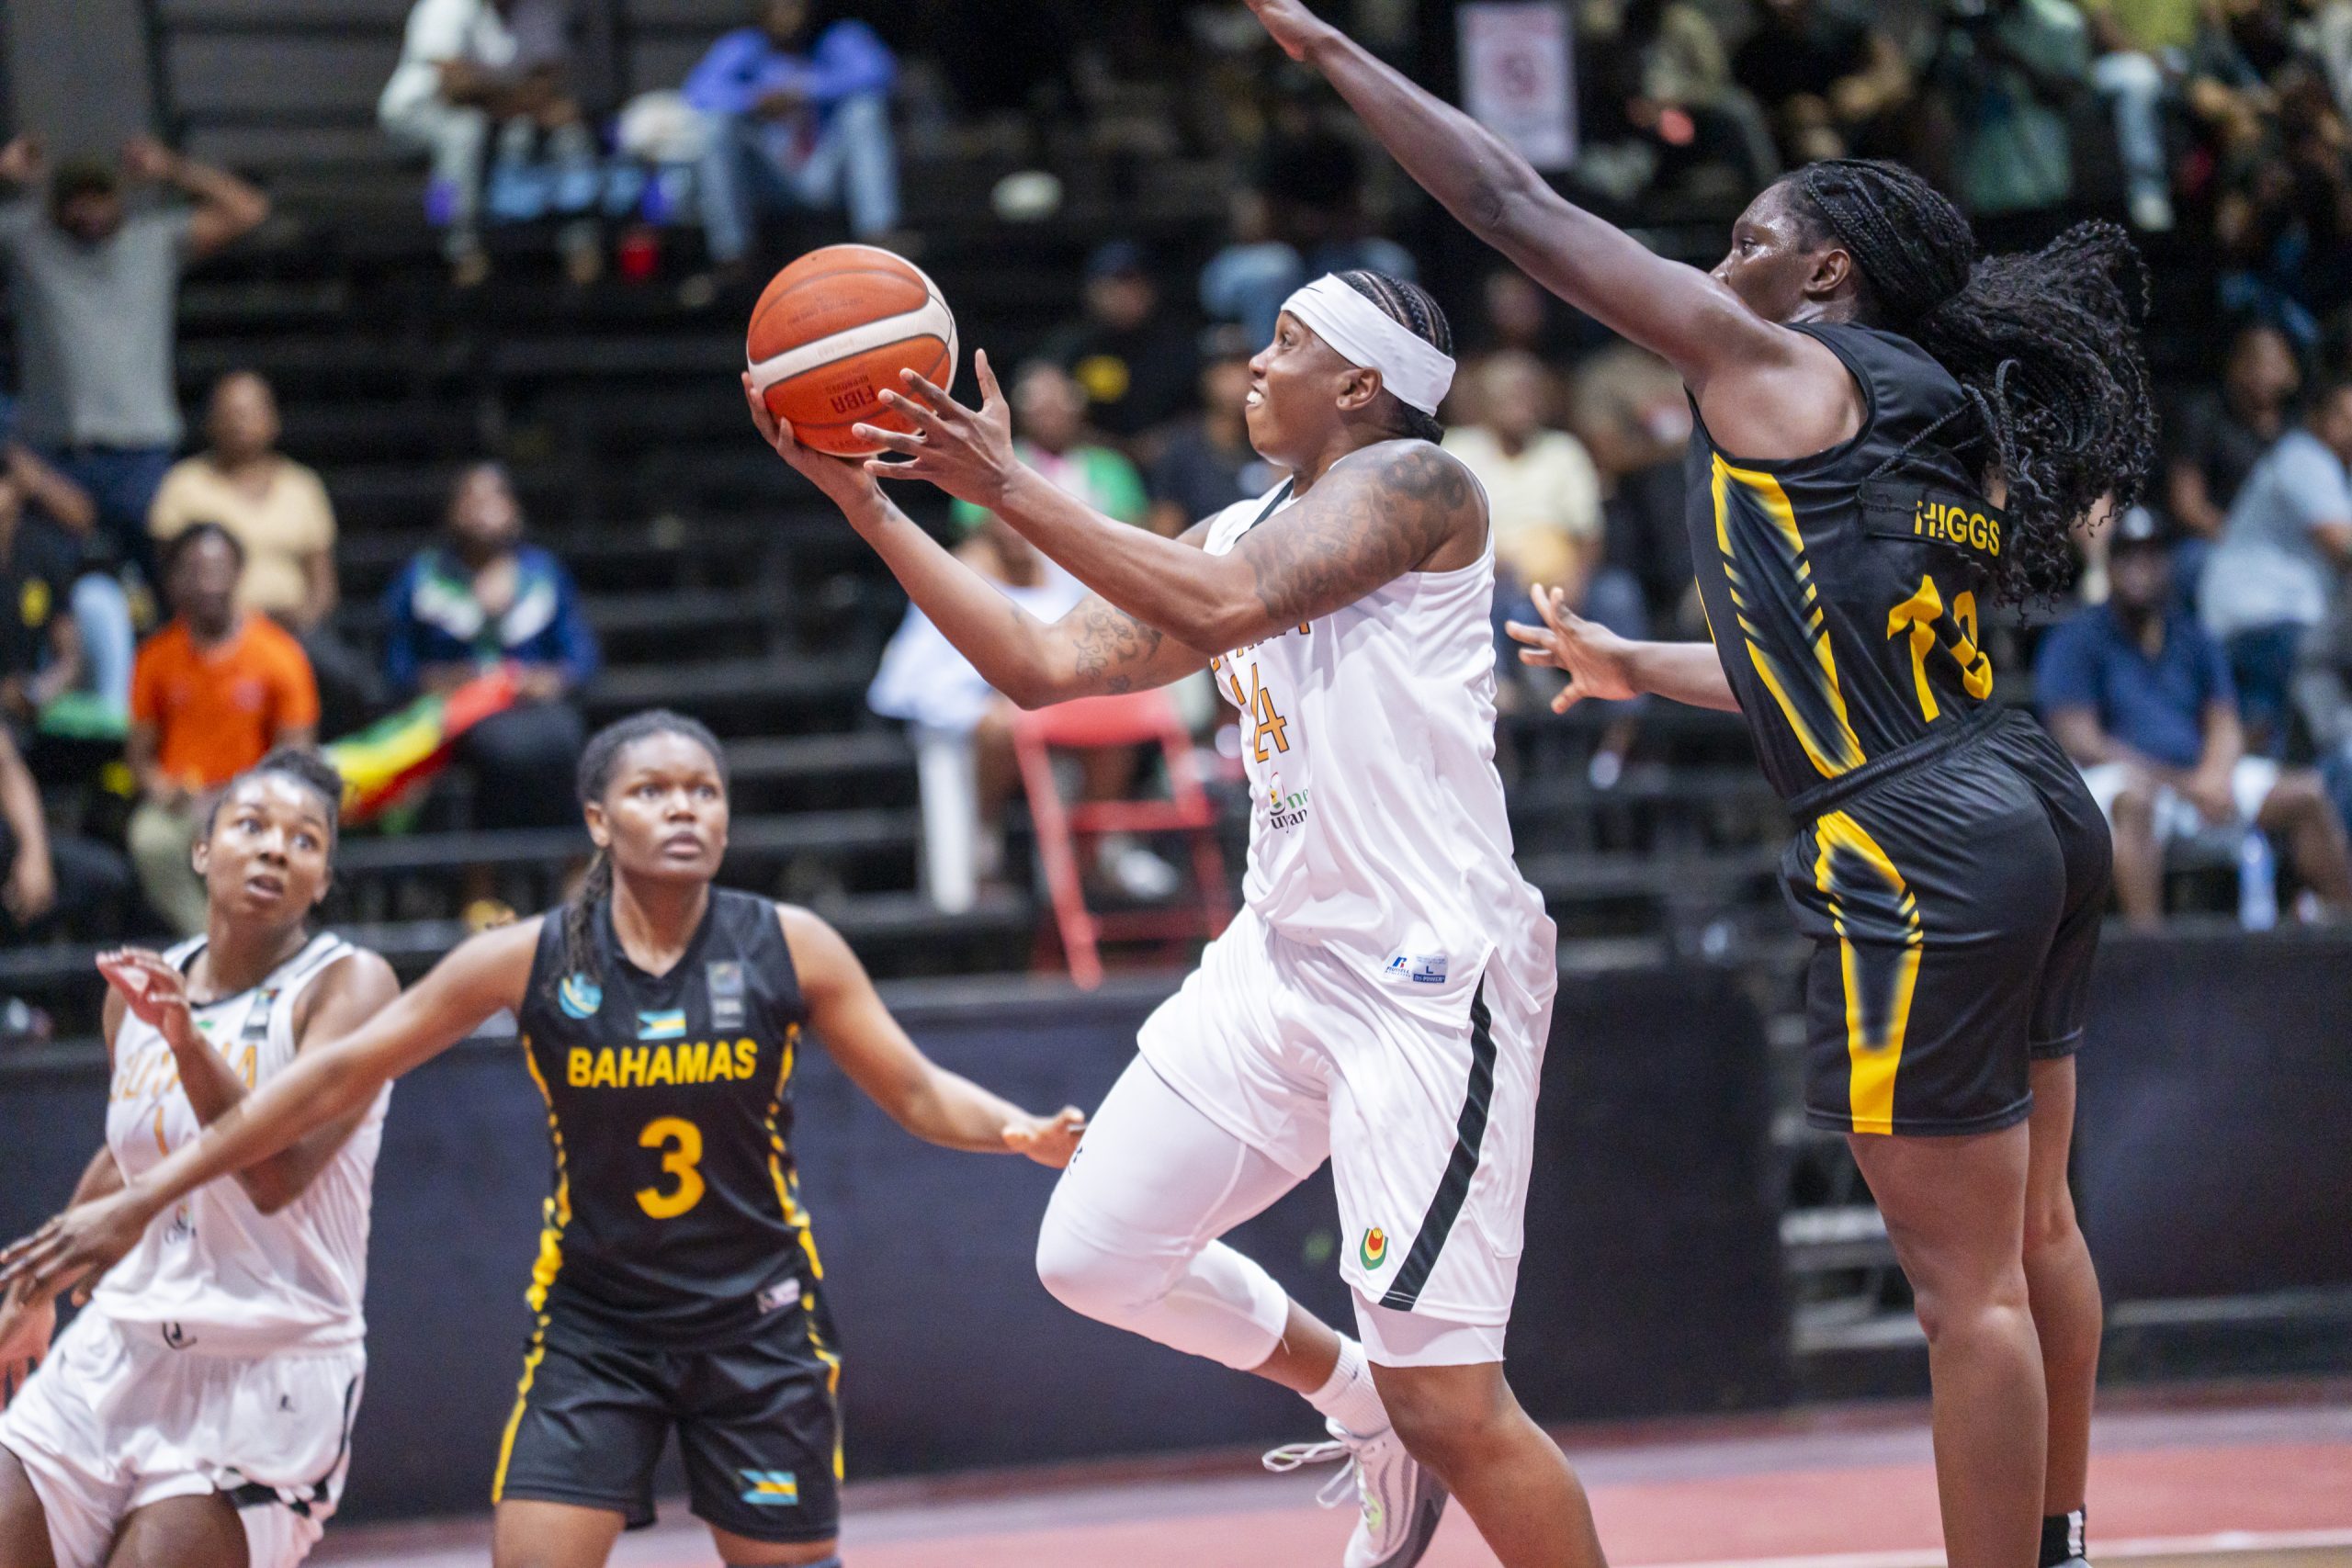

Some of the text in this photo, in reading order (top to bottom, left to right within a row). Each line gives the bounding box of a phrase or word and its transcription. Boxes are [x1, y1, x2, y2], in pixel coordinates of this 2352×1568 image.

[830, 384, 877, 414] FIBA
[1914, 501, 2001, 557] HIGGS
[1426, 965, 1434, 975] L
[567, 1038, 758, 1088] BAHAMAS
[635, 1116, 706, 1220] 3
